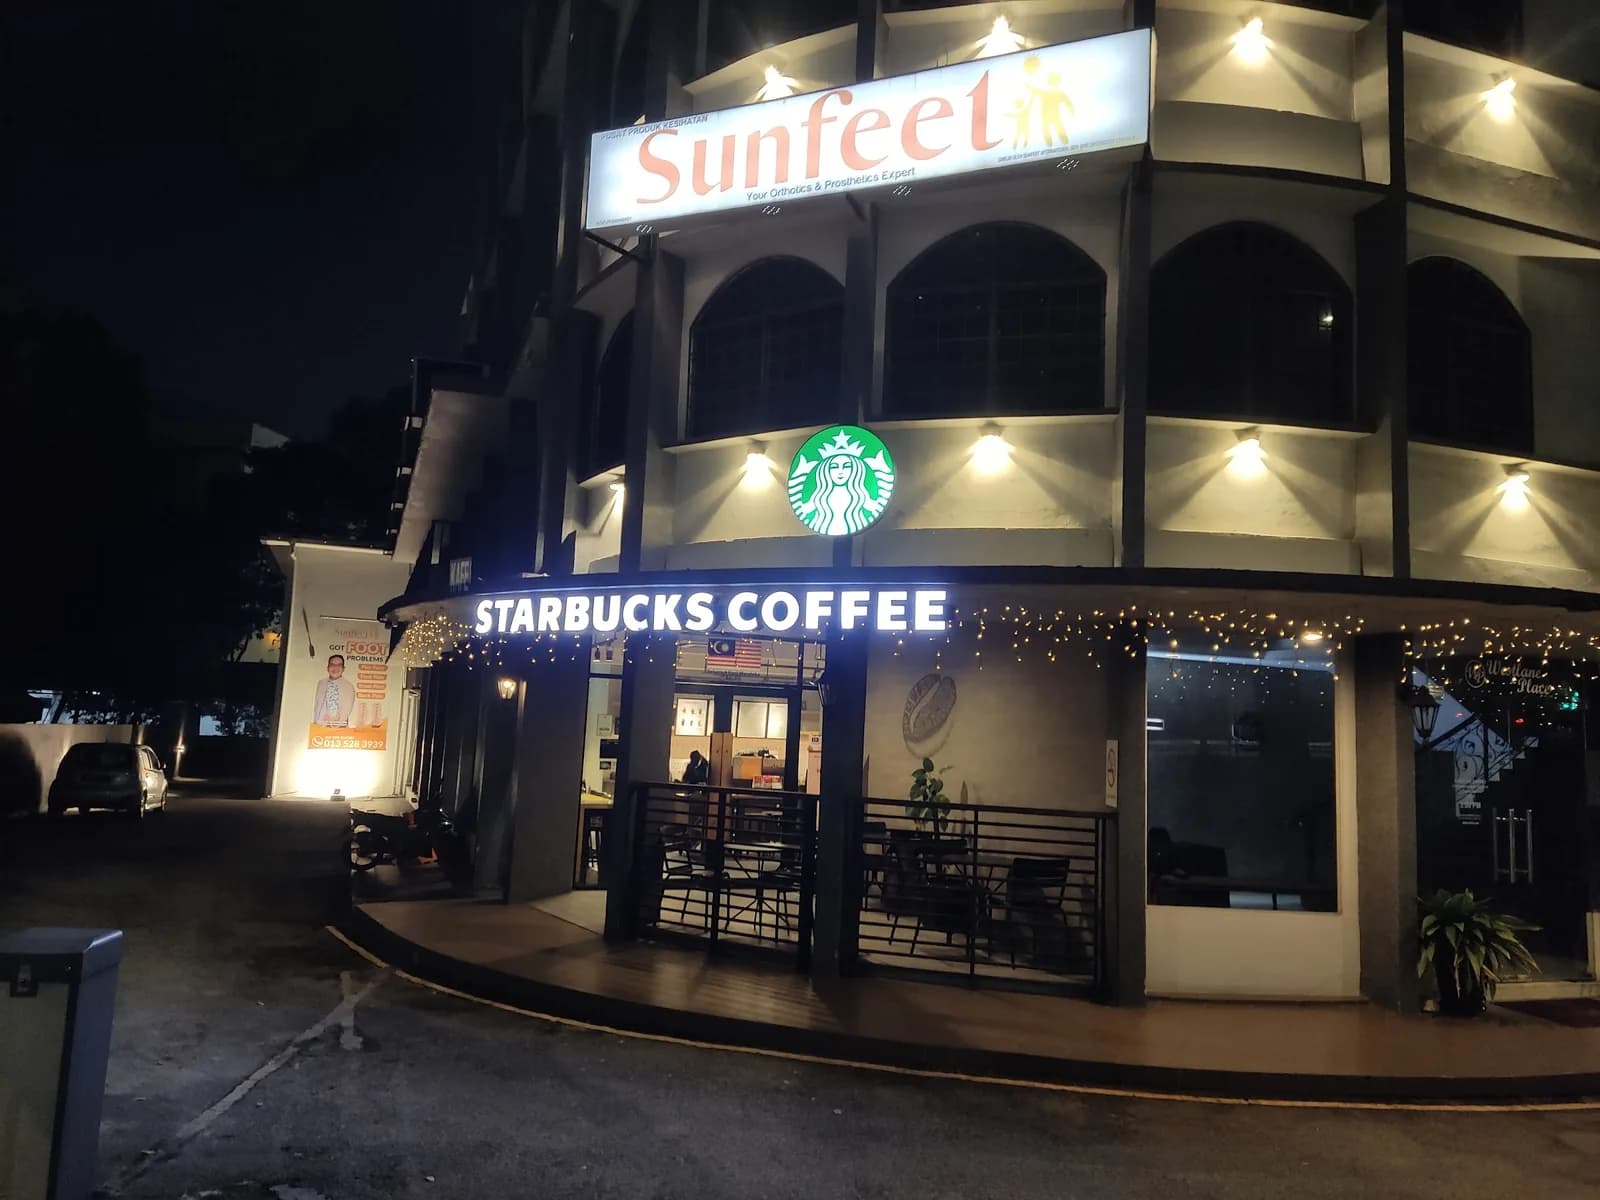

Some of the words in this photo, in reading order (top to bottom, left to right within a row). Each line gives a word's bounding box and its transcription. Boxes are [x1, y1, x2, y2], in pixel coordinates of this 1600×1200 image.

[628, 125, 661, 136] PRODUK
[663, 115, 708, 130] KESIHATAN
[636, 69, 1004, 204] Sunfeet
[747, 191, 768, 201] Your
[769, 183, 812, 197] Orthotics
[815, 182, 822, 191] &
[824, 174, 879, 190] Prosthetics
[881, 167, 916, 182] Expert
[475, 592, 716, 633] STARBUCKS
[727, 590, 947, 631] COFFEE
[346, 641, 388, 656] FOOT
[346, 655, 384, 663] PROBLEMS
[1516, 678, 1552, 695] Place
